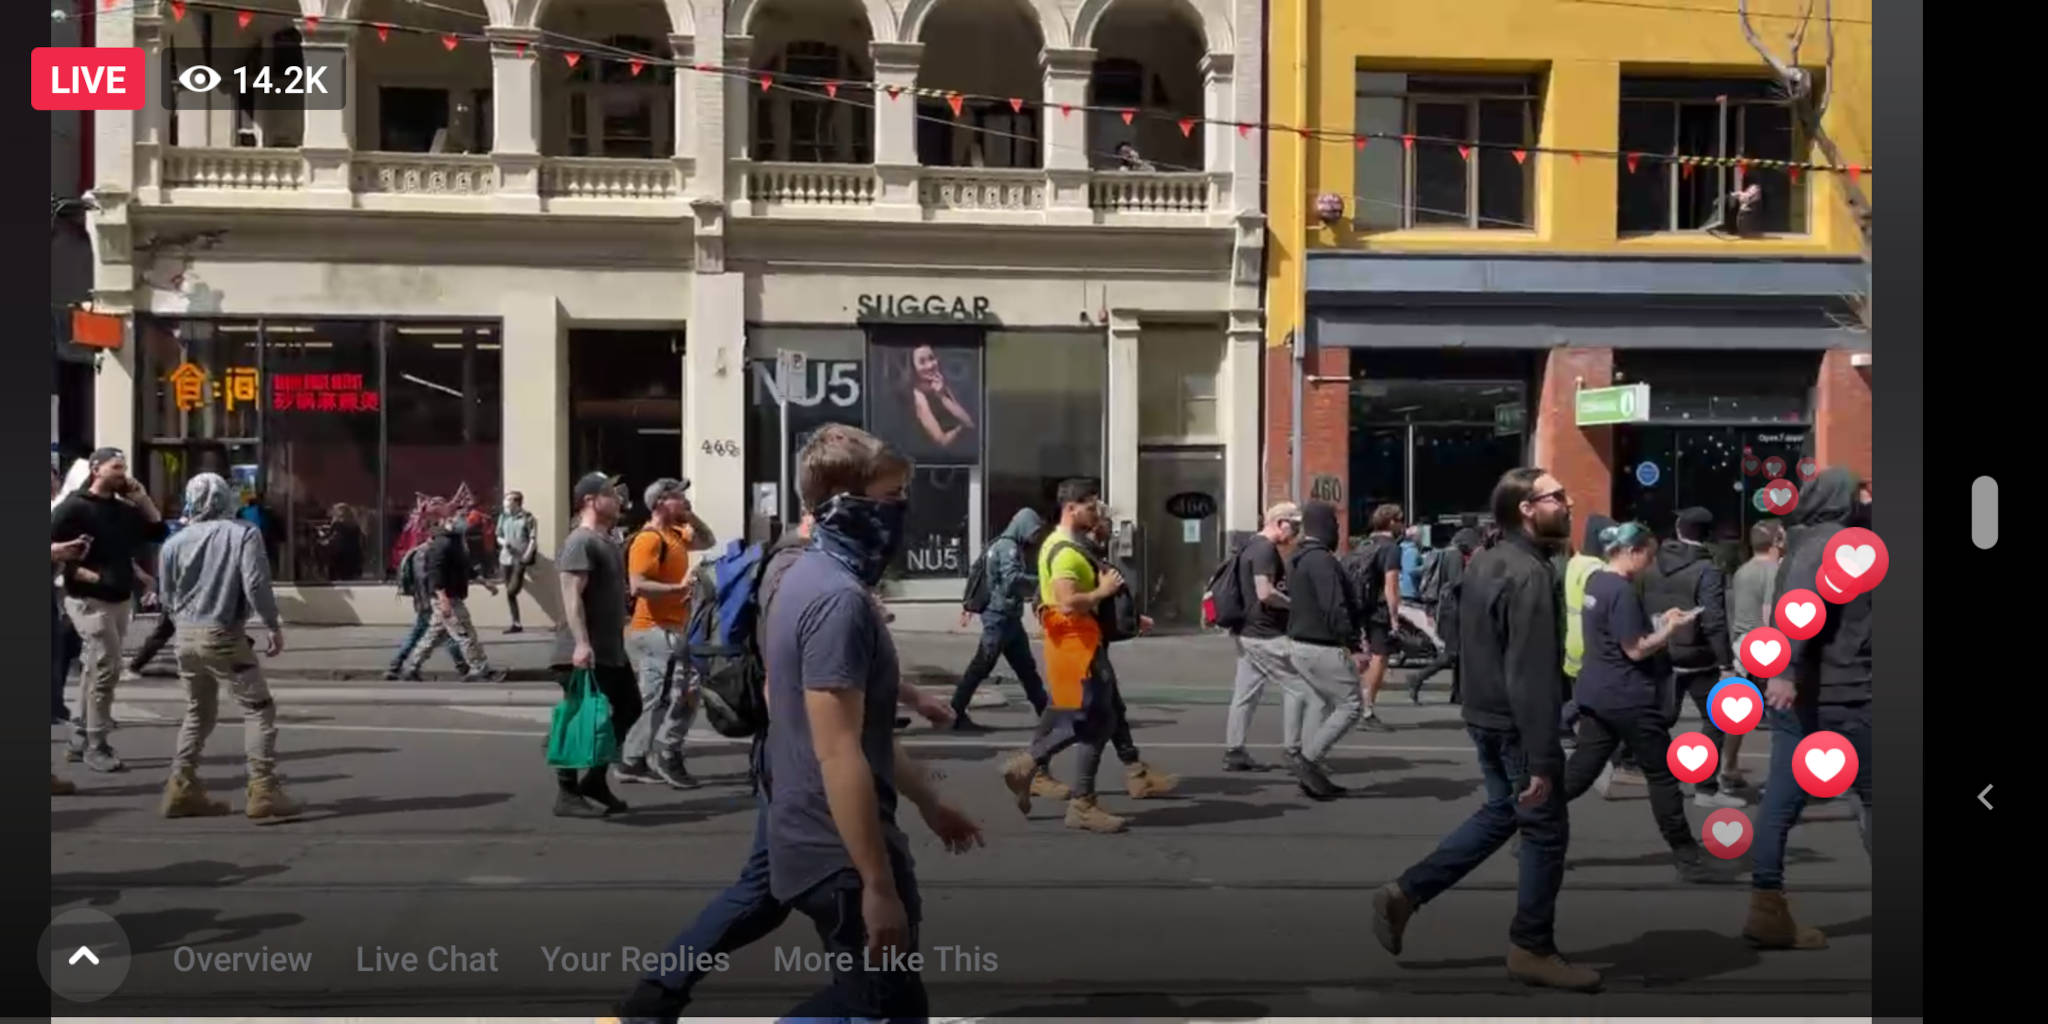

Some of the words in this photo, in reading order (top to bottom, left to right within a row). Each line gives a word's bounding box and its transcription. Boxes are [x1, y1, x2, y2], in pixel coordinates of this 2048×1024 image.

[857, 293, 990, 321] SUGGAR
[1310, 477, 1343, 502] 460
[907, 547, 959, 571] NU5
